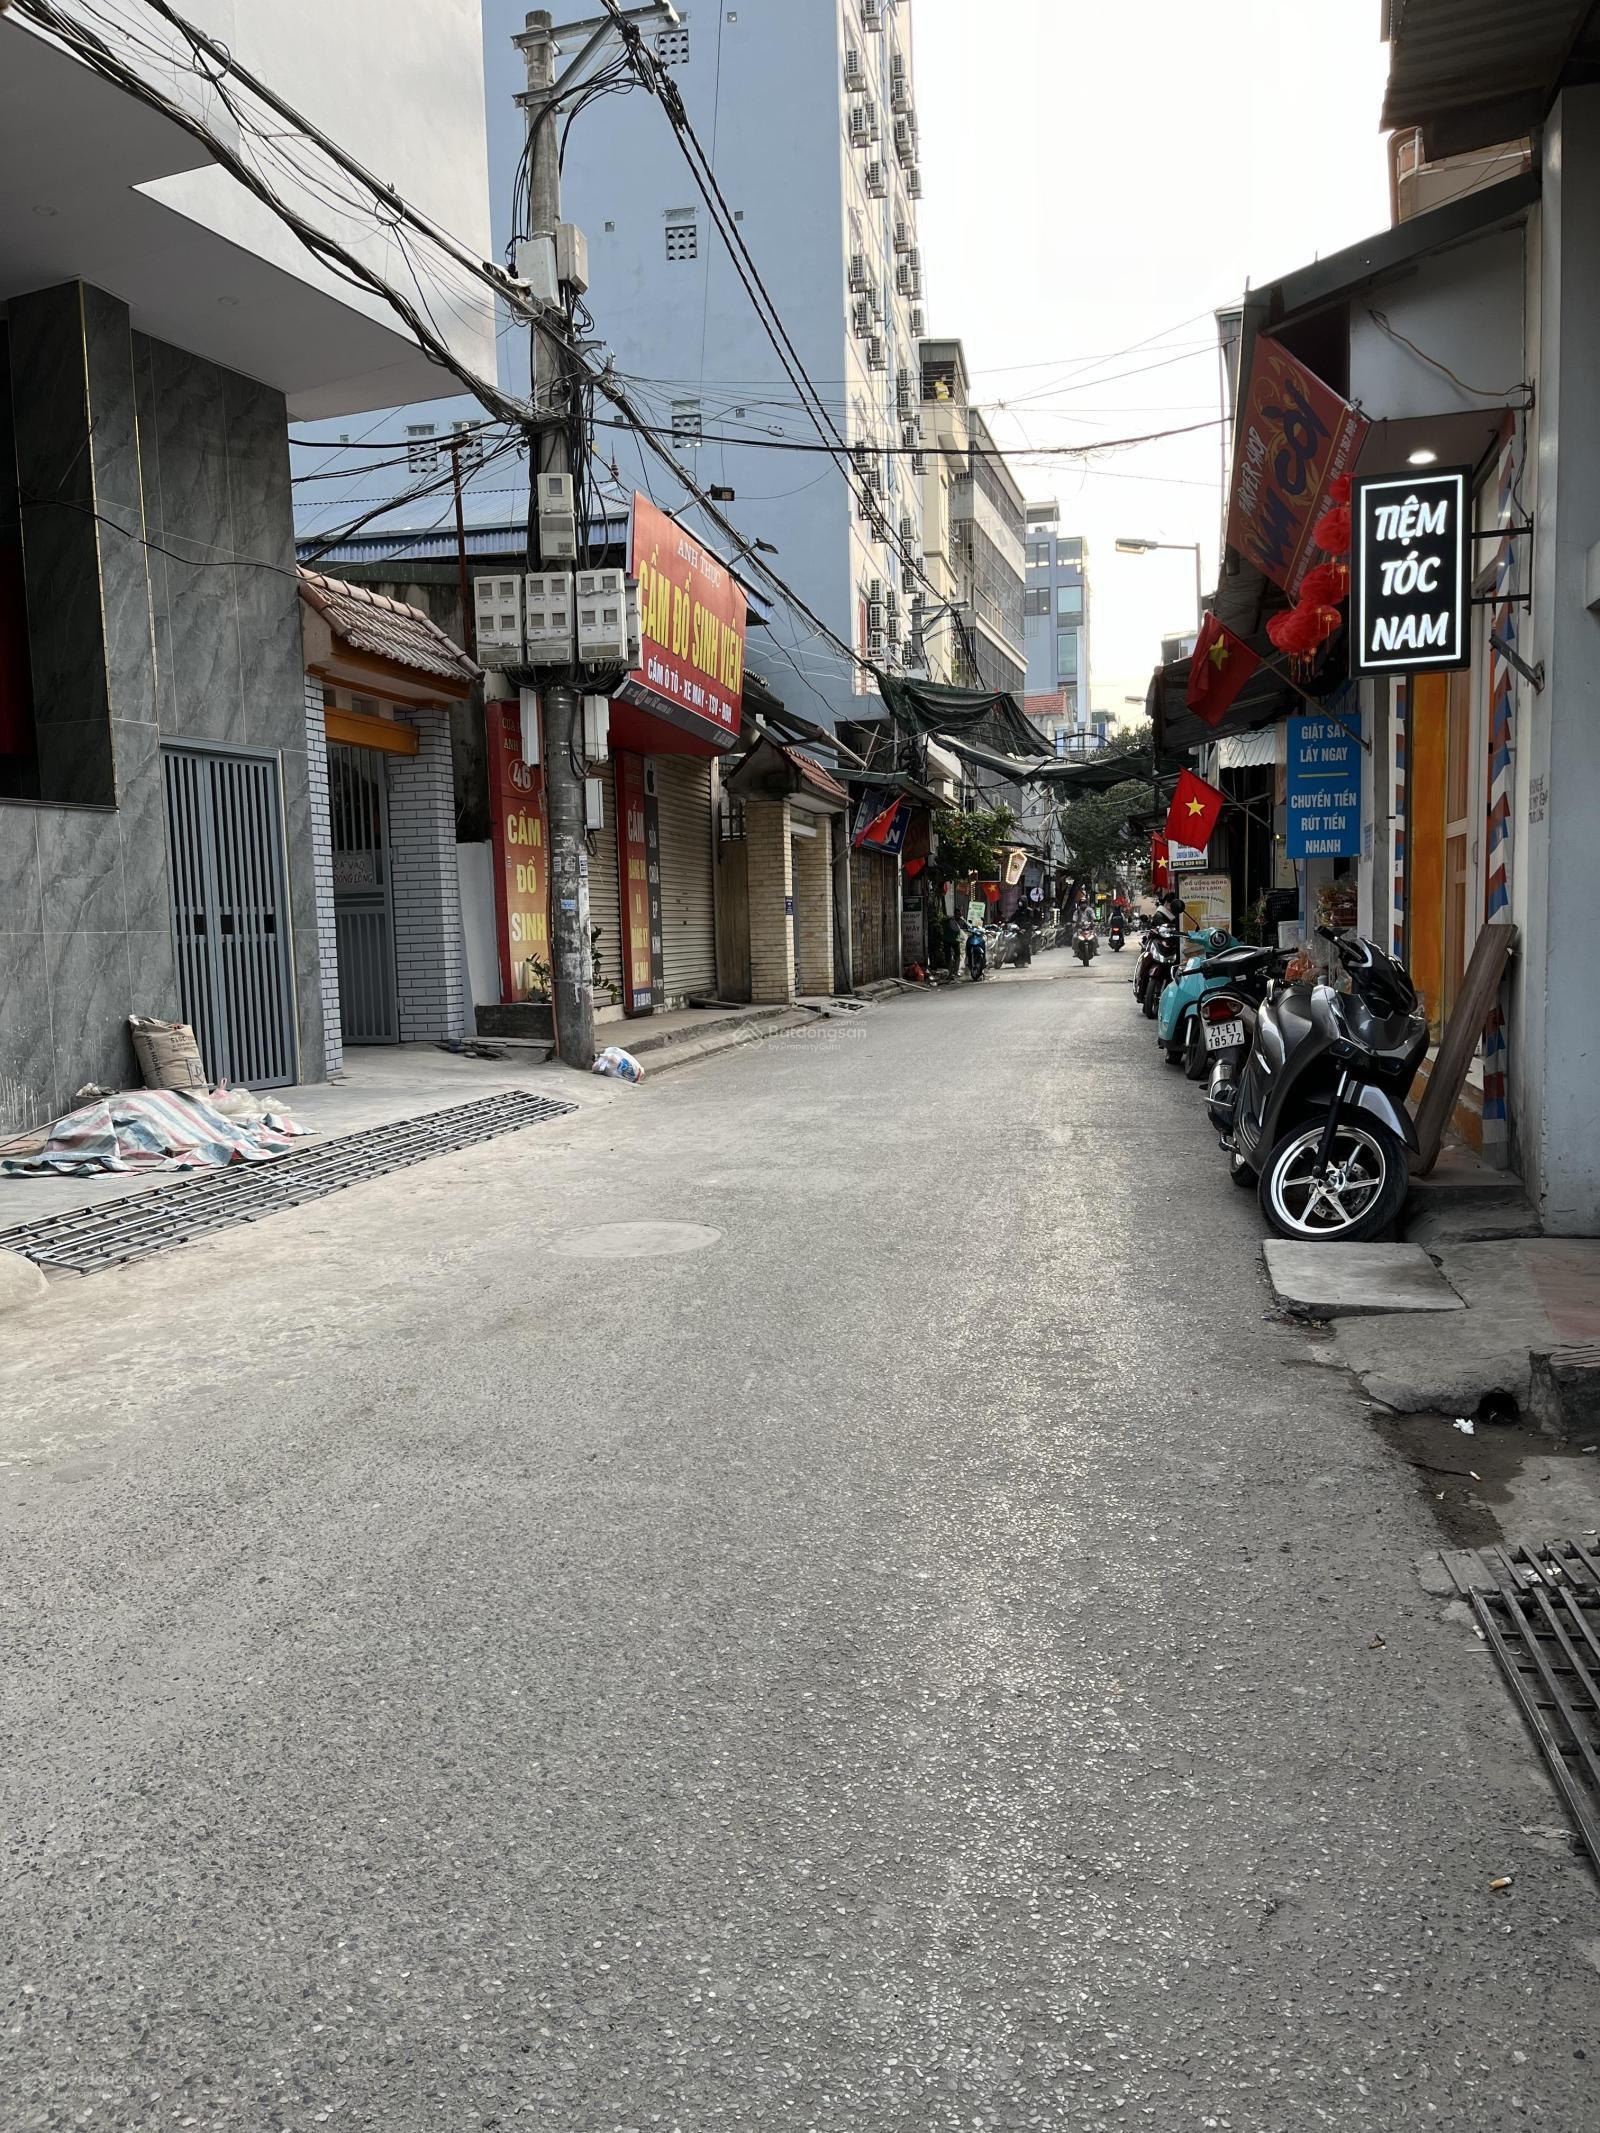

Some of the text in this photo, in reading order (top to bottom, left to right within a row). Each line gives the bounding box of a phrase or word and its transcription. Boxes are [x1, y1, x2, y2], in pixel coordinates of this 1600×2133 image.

[1374, 494, 1449, 546] TIỆM
[677, 538, 699, 569] ANH
[1380, 550, 1441, 596] TÓC
[1371, 611, 1450, 652] NAM
[691, 601, 719, 679] SINH
[720, 617, 743, 695] VIÊN
[670, 669, 679, 694] TÔ
[683, 678, 692, 701] XE
[691, 684, 705, 708] MÁY
[1301, 722, 1325, 742] GIẶT
[1300, 743, 1348, 763] LẤY NGAY
[512, 763, 532, 789] 46
[1290, 788, 1331, 809] CHUYỂN
[507, 806, 542, 847] CẦM
[1301, 814, 1321, 831] RÚT
[1305, 839, 1341, 854] NHANH
[516, 856, 537, 894] ĐỒ
[511, 912, 547, 941] SINH
[1208, 1032, 1243, 1048] 185.72
[1211, 1022, 1237, 1037] 21-E1
